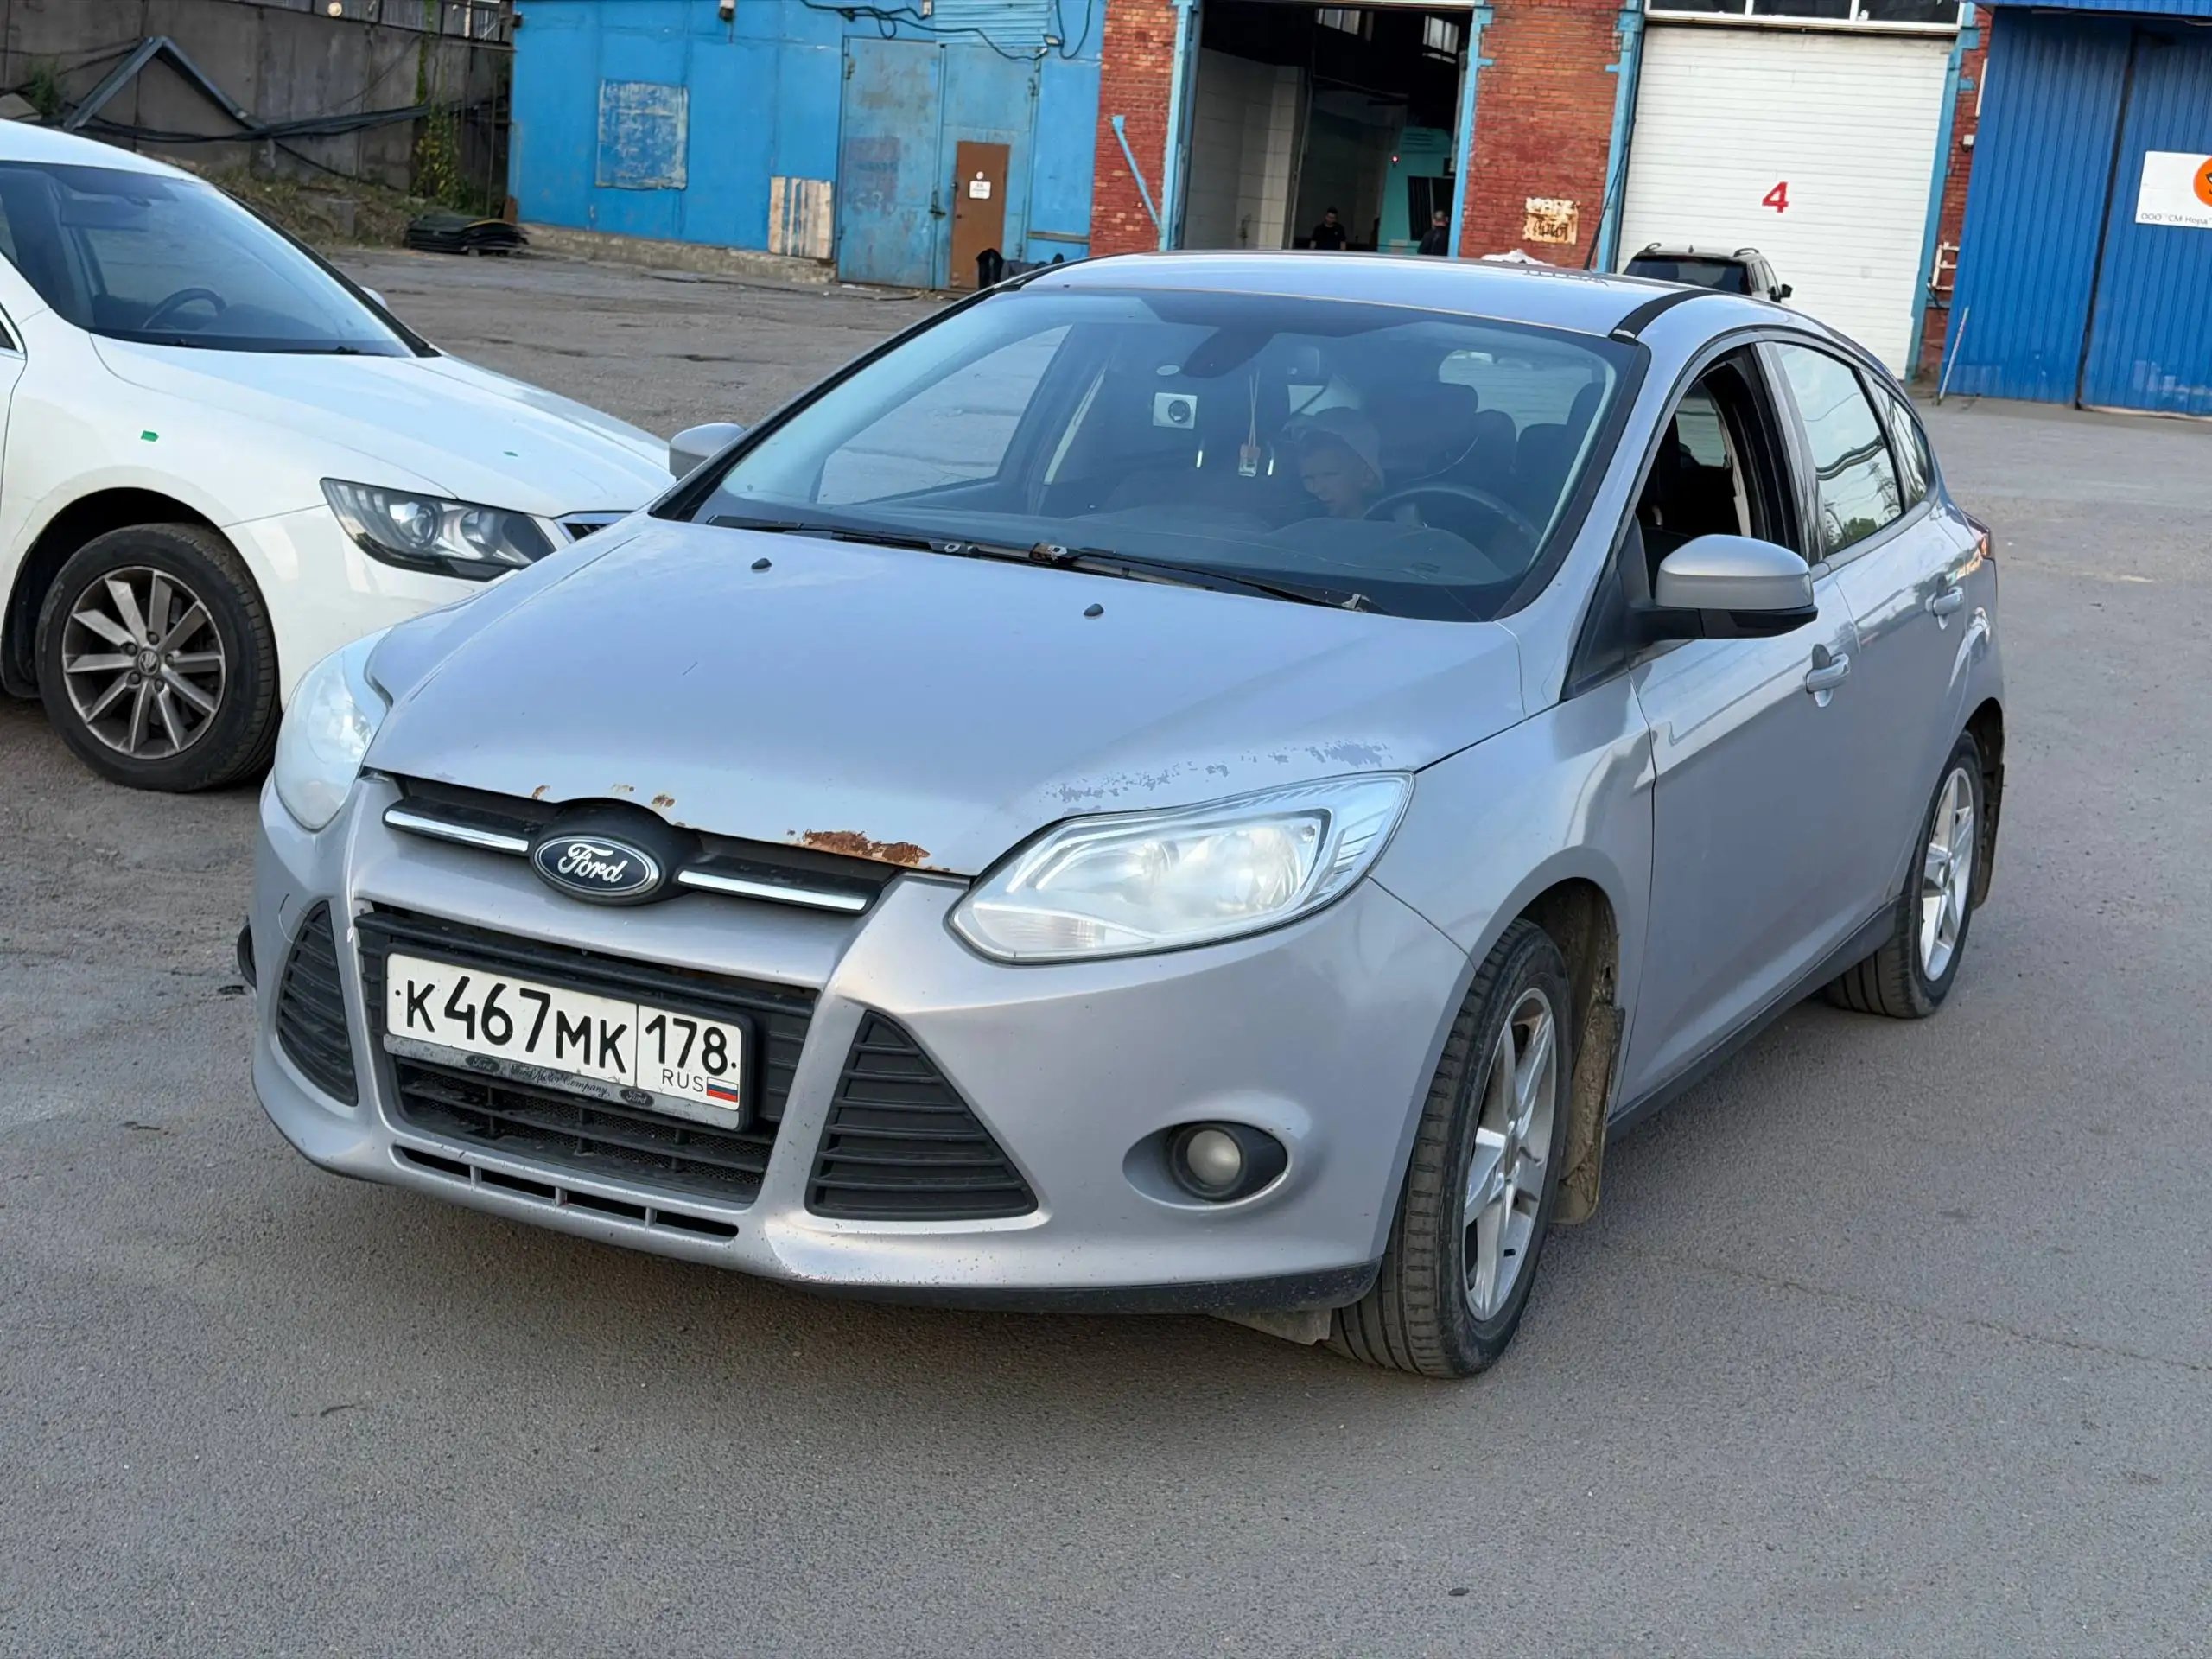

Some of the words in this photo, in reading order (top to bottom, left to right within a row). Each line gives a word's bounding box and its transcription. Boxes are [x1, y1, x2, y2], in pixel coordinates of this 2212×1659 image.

[1762, 181, 1789, 213] 4
[2141, 213, 2162, 221] ООО
[557, 843, 628, 883] Ford
[407, 976, 627, 1073] К467МК
[645, 1014, 728, 1076] 178
[662, 1068, 704, 1092] RUS
[626, 1091, 647, 1105] Ford
